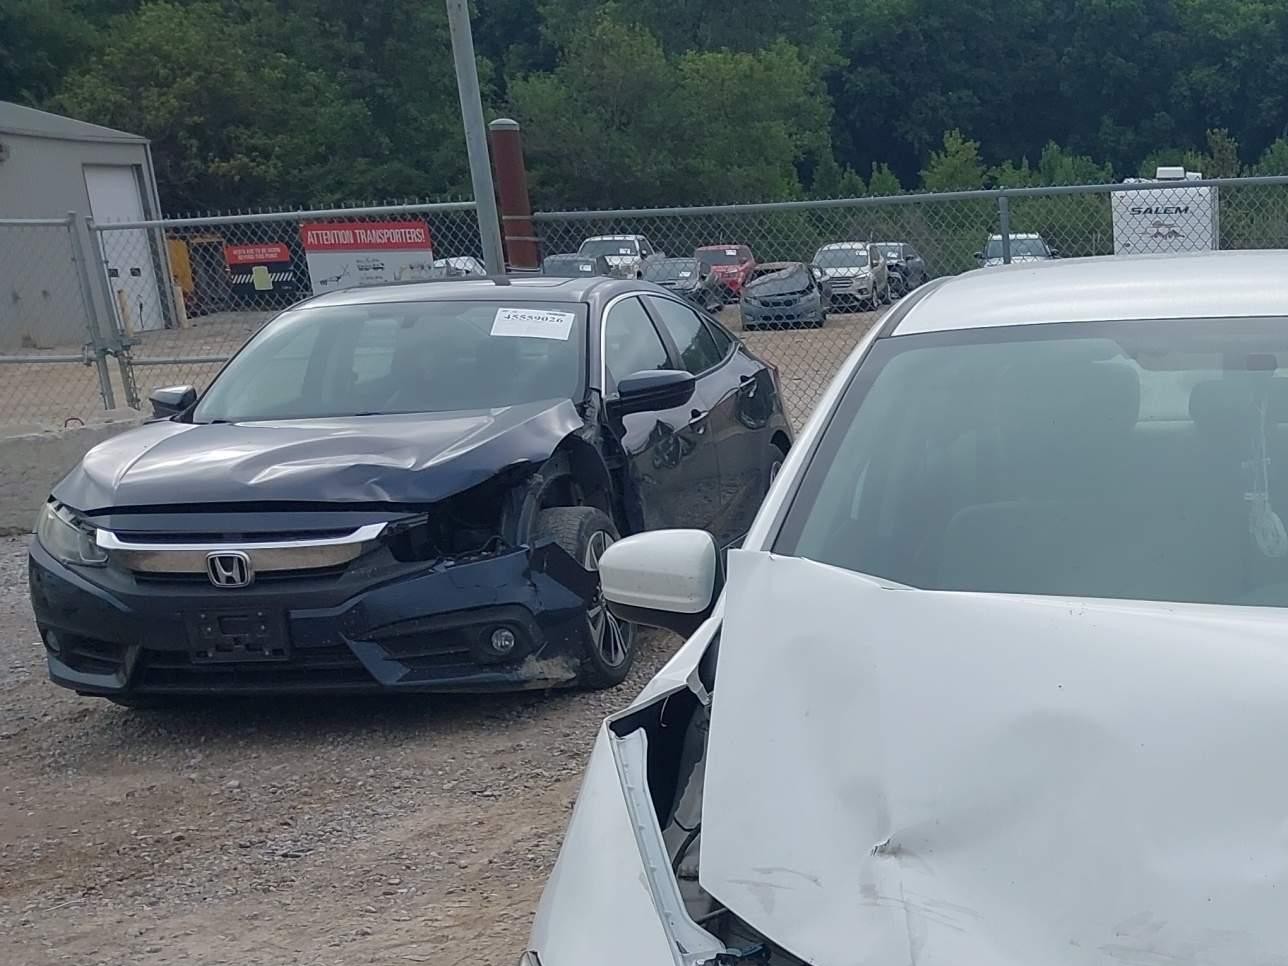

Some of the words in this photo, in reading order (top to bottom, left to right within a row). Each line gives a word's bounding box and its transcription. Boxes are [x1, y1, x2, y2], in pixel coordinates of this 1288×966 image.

[1129, 206, 1190, 215] SALEM
[307, 229, 354, 245] ATTENTION
[354, 228, 426, 243] TRANSPORTERS!
